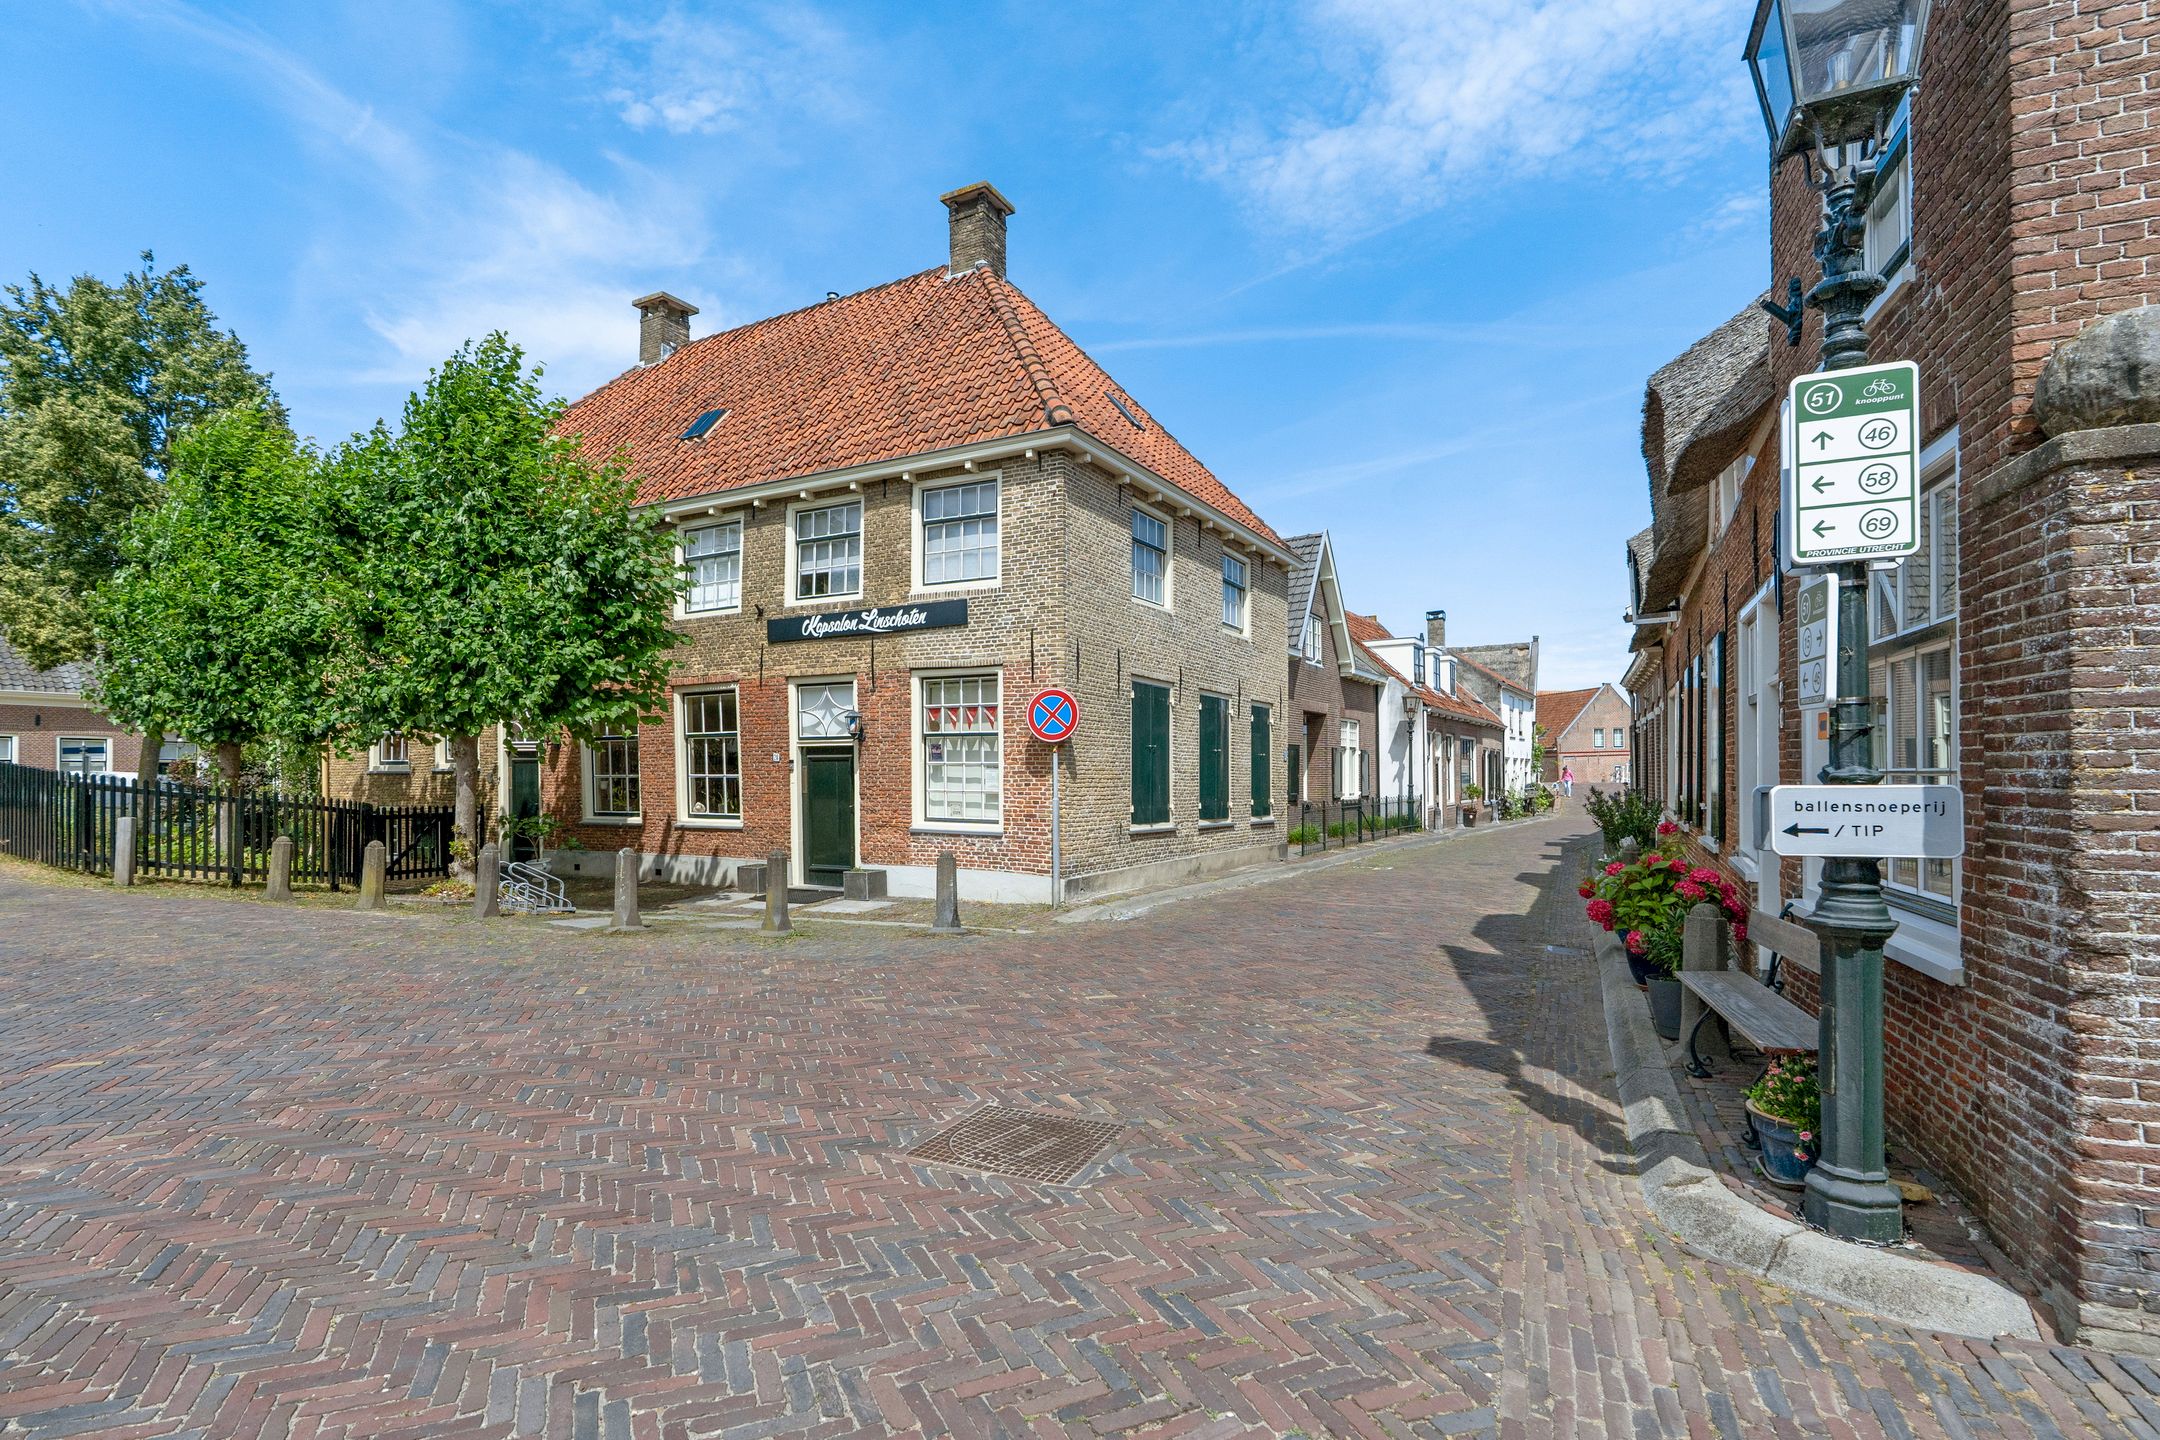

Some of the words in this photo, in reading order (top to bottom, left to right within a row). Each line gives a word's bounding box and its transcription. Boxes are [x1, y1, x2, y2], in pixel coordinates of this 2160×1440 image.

[1810, 390, 1835, 408] 51
[1855, 393, 1905, 406] knooppunt
[1864, 426, 1891, 442] 46
[1865, 471, 1891, 488] 58
[1866, 516, 1892, 533] 69
[1806, 546, 1857, 558] PROVINCIE
[1859, 543, 1906, 554] UTRECHT
[1802, 601, 1809, 616] 51
[802, 614, 859, 638] Kapsalon
[858, 608, 927, 633] Linschoten
[1794, 801, 1946, 817] ballensnoeperij
[1852, 825, 1884, 837] TIP
